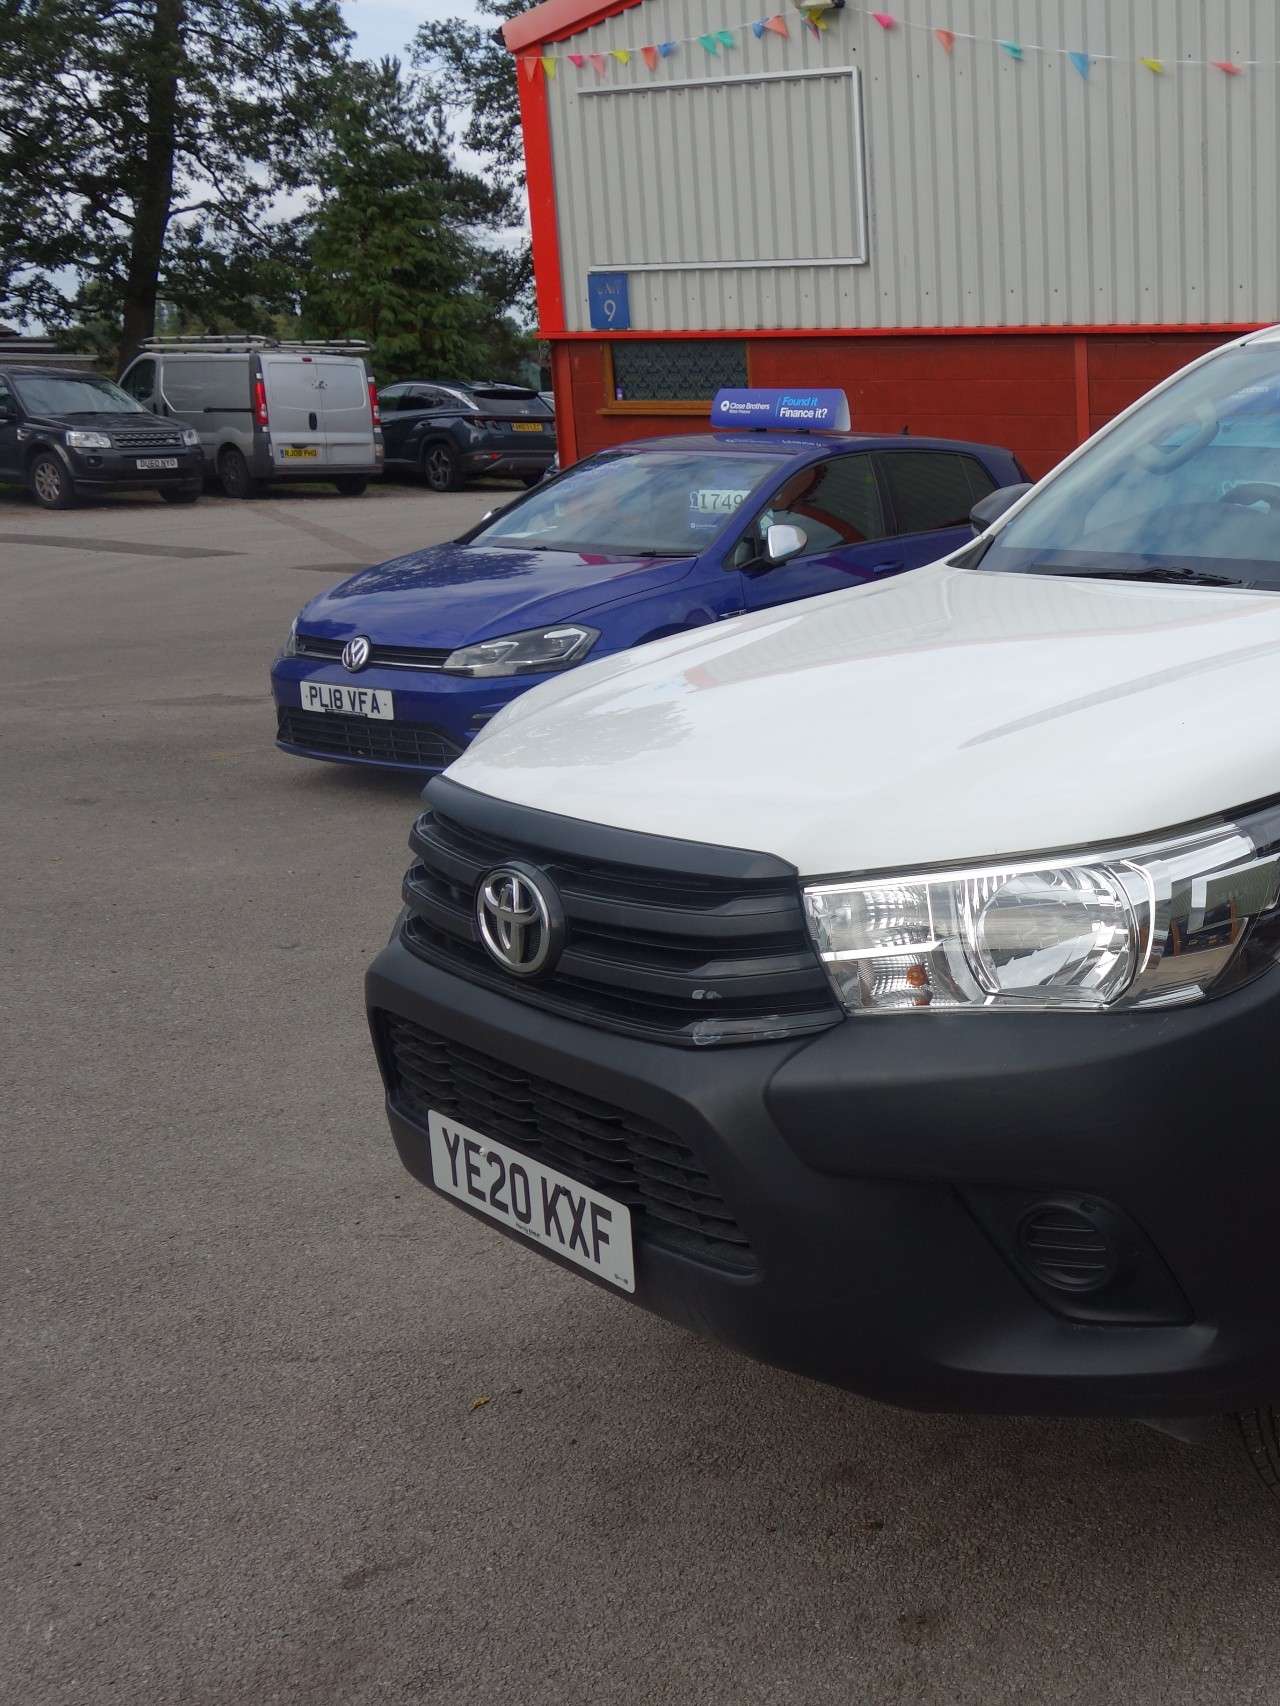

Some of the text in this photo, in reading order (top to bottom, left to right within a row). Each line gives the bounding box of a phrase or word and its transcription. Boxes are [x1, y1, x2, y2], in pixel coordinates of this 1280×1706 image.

[603, 299, 616, 322] 9
[782, 396, 811, 406] Found
[780, 407, 828, 419] Finance it?
[309, 685, 381, 714] PL18 VFA
[441, 1127, 613, 1264] YE20 KXF
